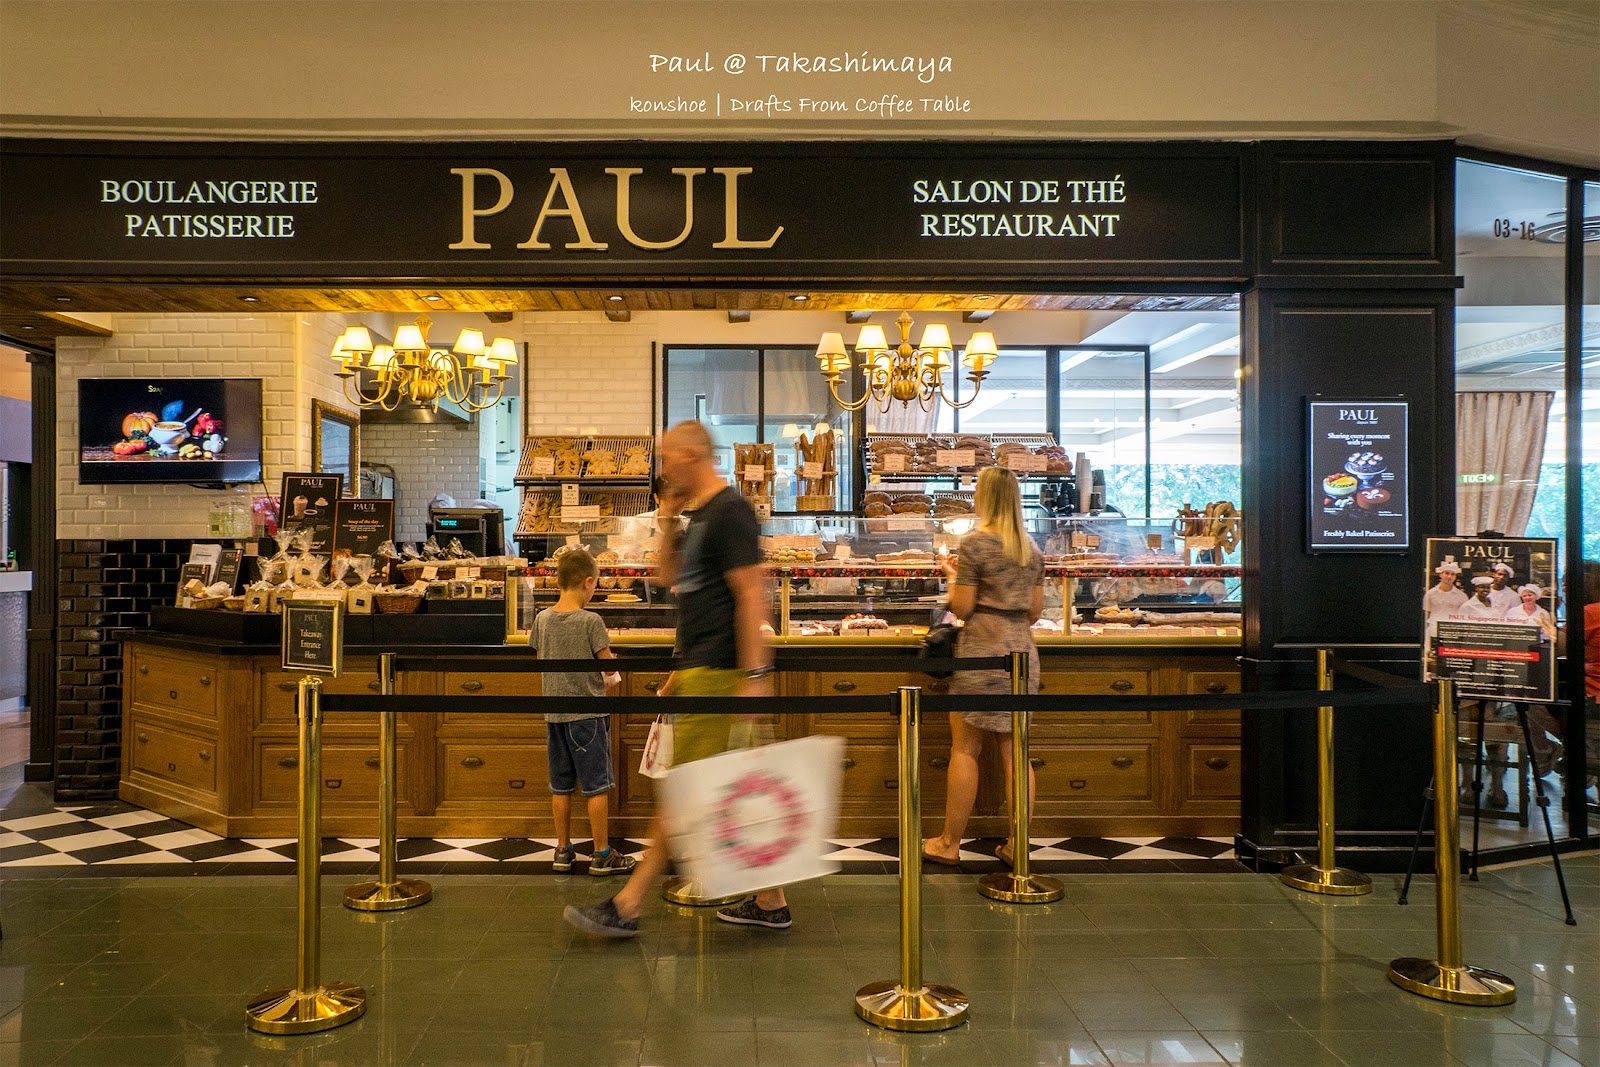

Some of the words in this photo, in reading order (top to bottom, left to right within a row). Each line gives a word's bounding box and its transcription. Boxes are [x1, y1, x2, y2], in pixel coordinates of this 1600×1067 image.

[100, 180, 319, 205] BOULANGERIE
[913, 180, 1014, 204] SALON
[1019, 180, 1061, 204] DE
[1066, 175, 1127, 204] THÉ
[448, 167, 785, 251] PAUL
[124, 213, 296, 239] PATISSERIE
[920, 214, 1120, 238] RESTAURANT
[1494, 218, 1535, 241] 03-16
[1338, 409, 1379, 421] PAUL
[1328, 432, 1350, 441] Sharing
[1324, 530, 1345, 538] Freshly
[1464, 545, 1515, 558] PAUL
[300, 628, 322, 640] Takeaway
[300, 640, 321, 649] Entrance
